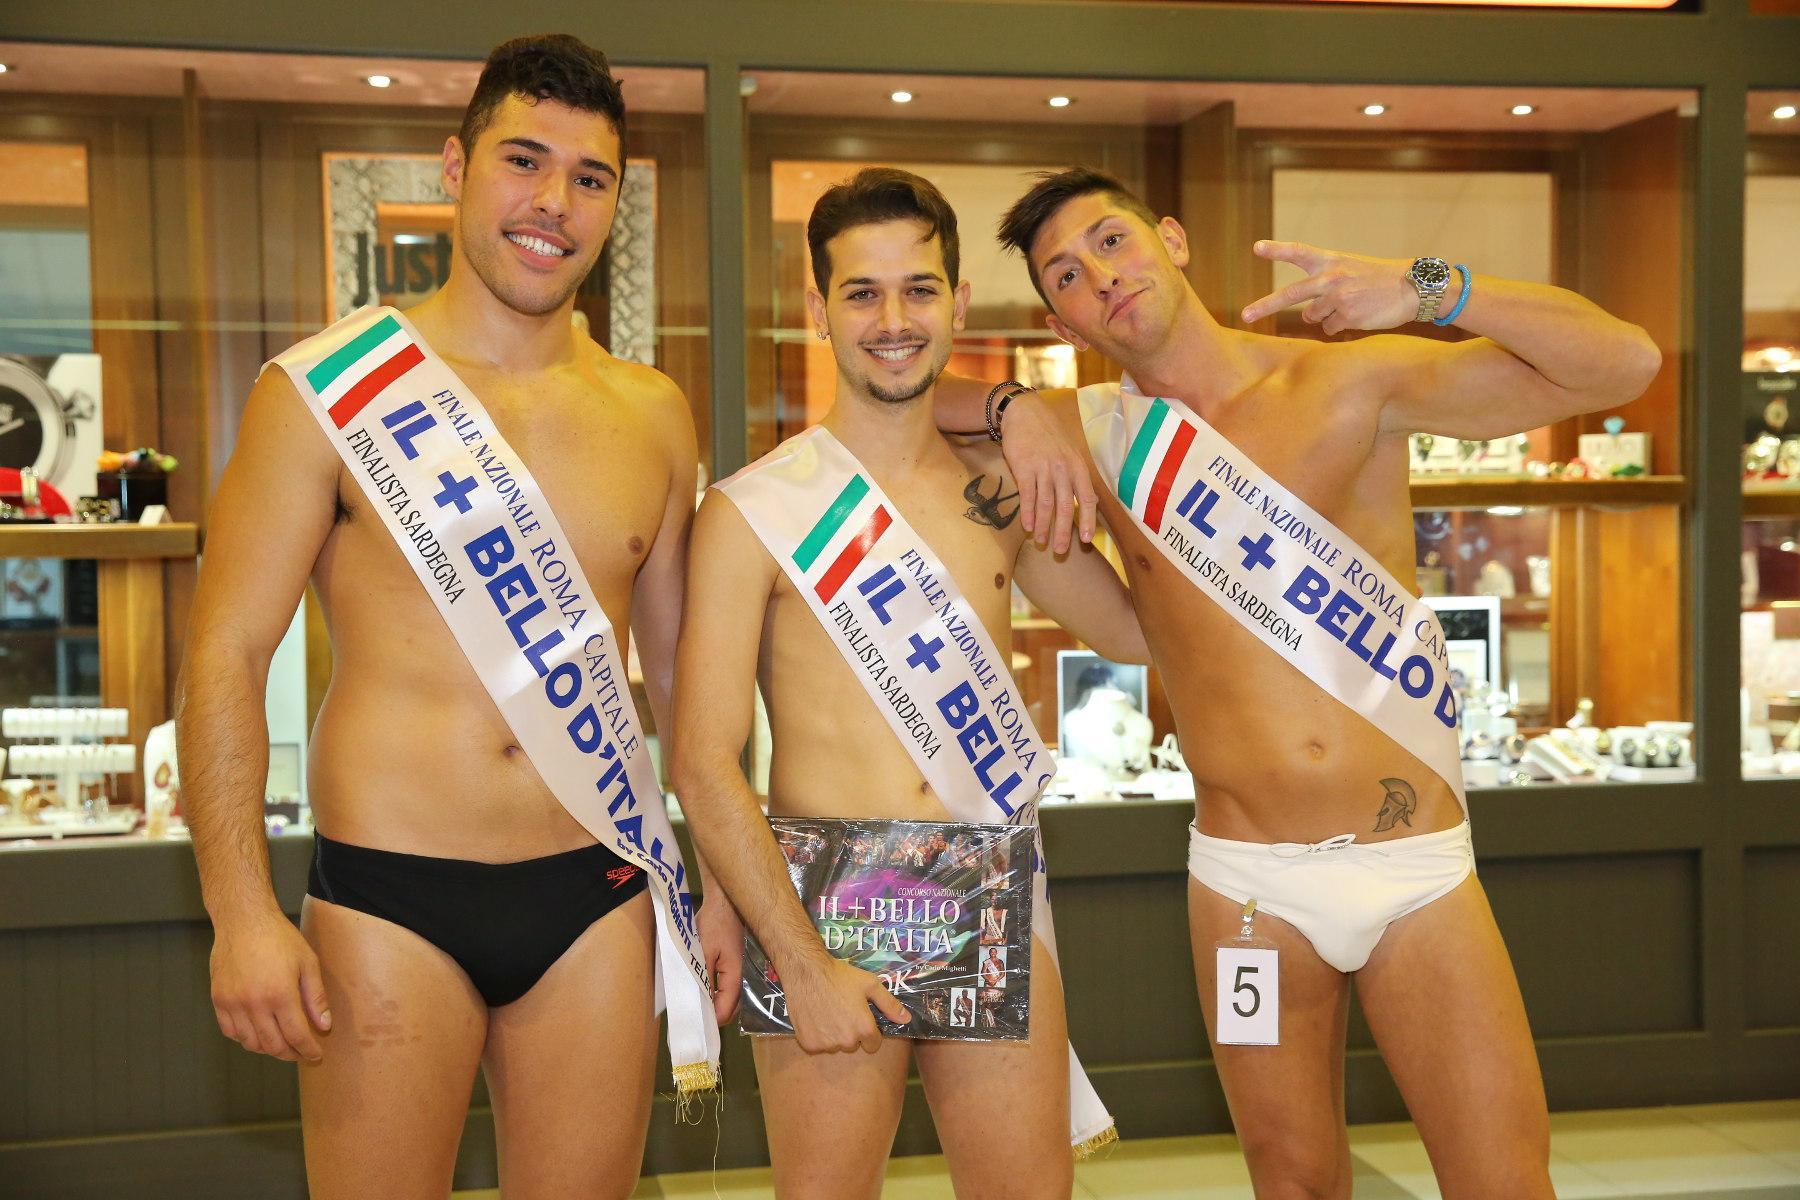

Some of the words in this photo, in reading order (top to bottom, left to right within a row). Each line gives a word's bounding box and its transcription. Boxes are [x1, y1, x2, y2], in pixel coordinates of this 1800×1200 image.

[346, 428, 413, 516] FINALISTA
[400, 510, 466, 605] SARDEGNA
[381, 400, 438, 461] IL
[463, 524, 582, 709] BELLO
[432, 389, 482, 446] FINALE
[470, 443, 541, 538] NAZIONALE
[530, 538, 587, 631] ROMA
[584, 634, 639, 759] CAPITALE
[857, 563, 907, 626] IL
[1163, 526, 1228, 592] FINALISTA
[1226, 582, 1303, 651] SARDEGNA
[1175, 479, 1222, 540] IL
[1281, 564, 1434, 699] BELLO
[1207, 455, 1260, 505] FINALE
[1255, 496, 1341, 568] NAZIONALE
[1341, 557, 1407, 628] ROMA
[829, 601, 889, 682] FINALISTA
[879, 676, 942, 760] SARDEGNA
[900, 548, 946, 605] FINALE
[935, 601, 997, 690] NAZIONALE
[991, 688, 1037, 773] ROMA
[898, 887, 932, 897] CONCORSO
[1233, 966, 1260, 1018] 5
